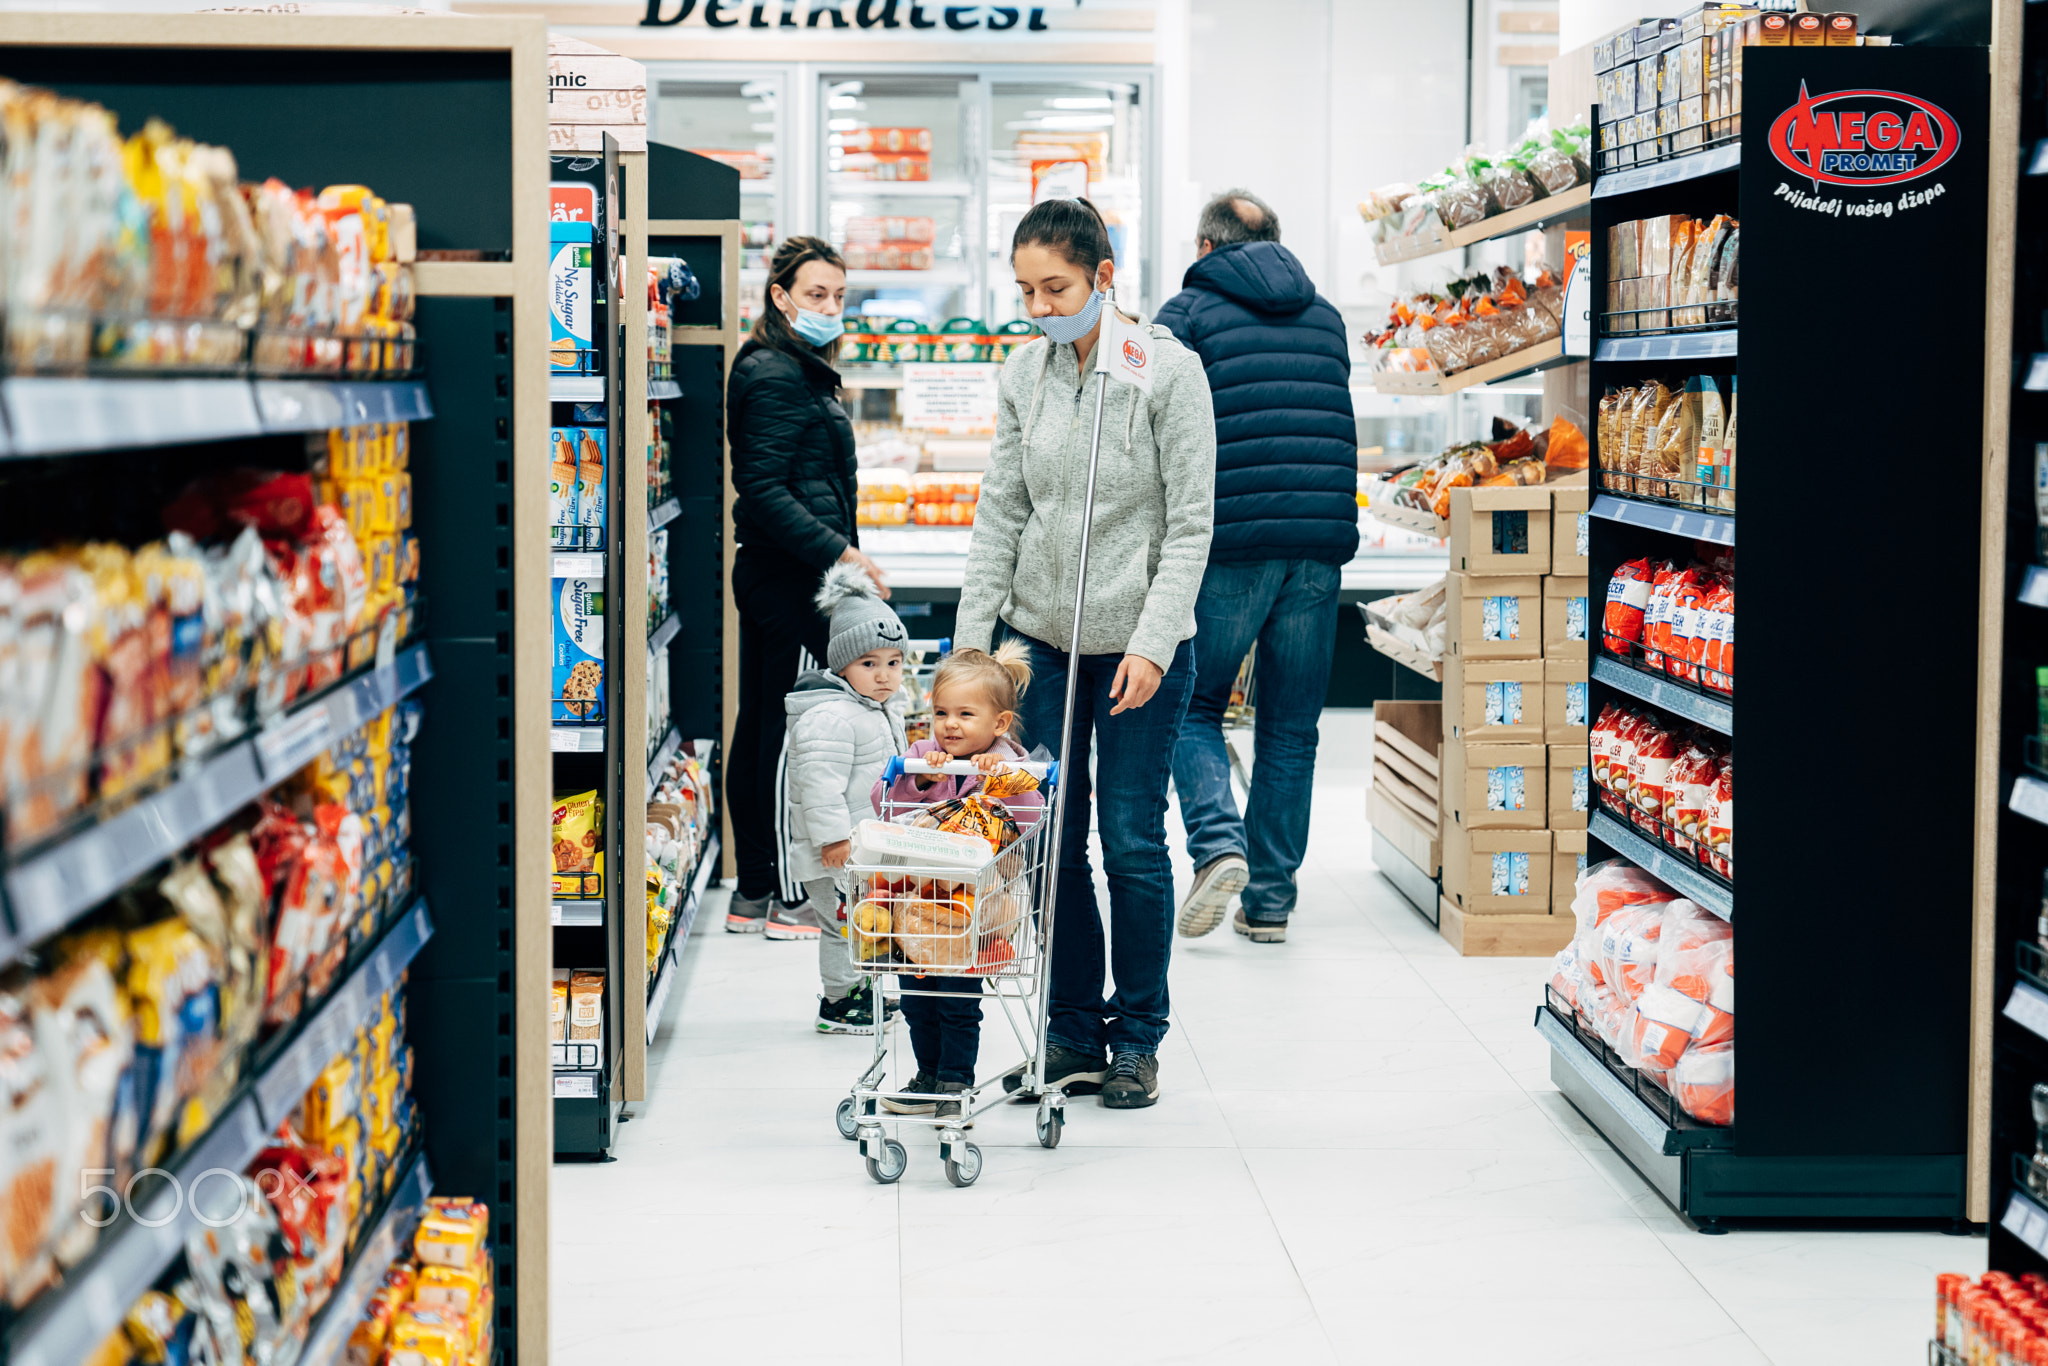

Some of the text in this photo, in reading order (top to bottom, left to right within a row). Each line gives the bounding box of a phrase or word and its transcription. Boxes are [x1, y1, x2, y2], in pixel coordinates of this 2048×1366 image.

[1790, 110, 1939, 152] MEGA
[1823, 153, 1918, 172] PROMET
[1773, 182, 1946, 218] Prijatelj vašeg džepa
[555, 274, 564, 304] Added
[560, 267, 579, 330] No Sugar
[557, 526, 567, 546] Suga
[583, 526, 594, 546] Suga
[570, 580, 588, 618] Sugar
[584, 592, 593, 616] gullón
[574, 618, 588, 643] Free
